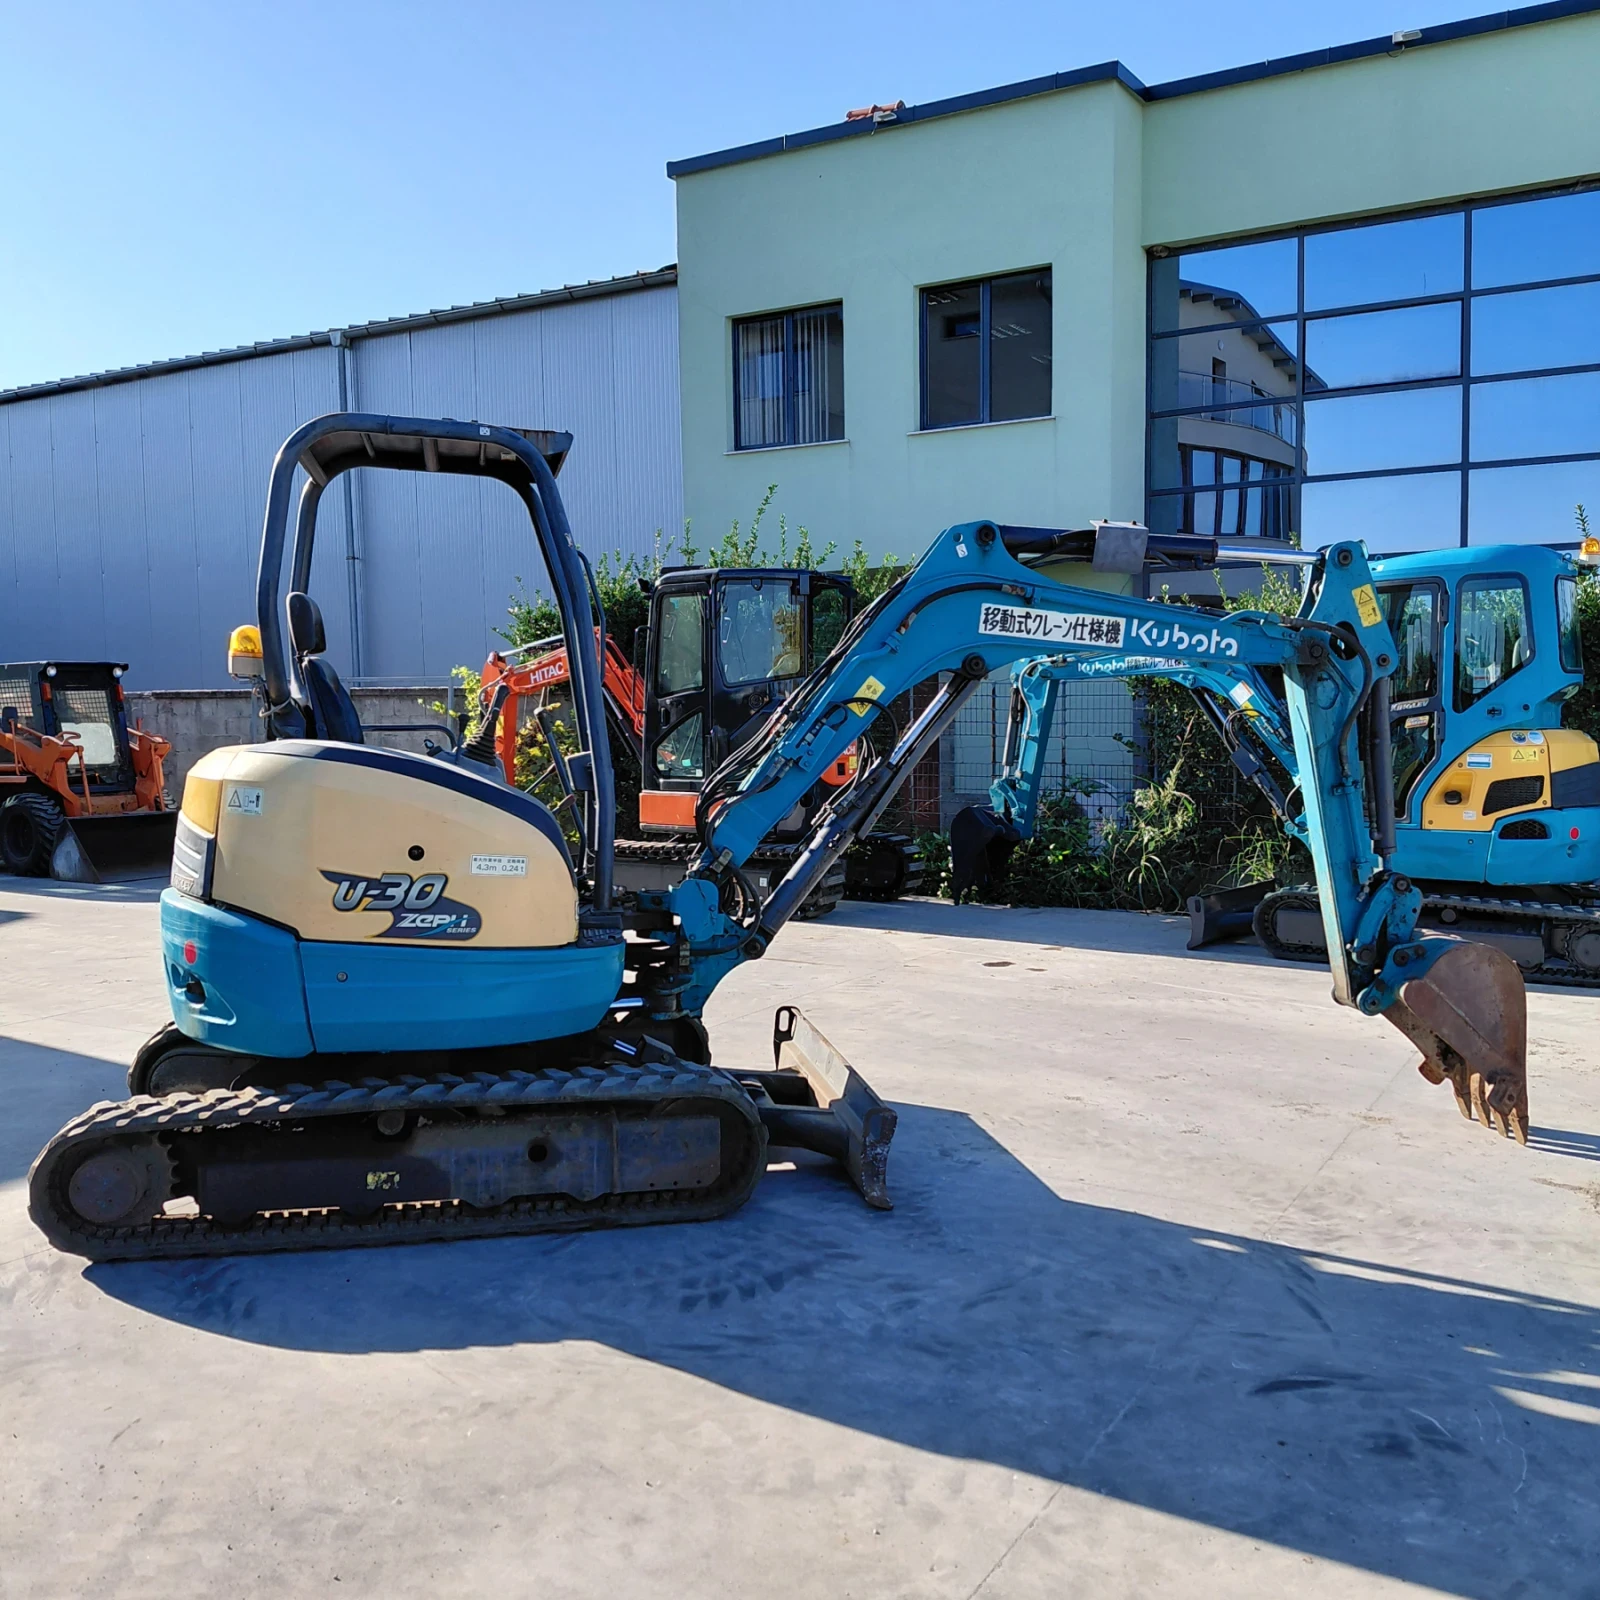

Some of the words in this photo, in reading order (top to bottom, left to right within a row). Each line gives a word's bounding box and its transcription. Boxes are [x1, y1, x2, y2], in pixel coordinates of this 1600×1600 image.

[982, 605, 1121, 645] 移動式クレーン仕様機
[1131, 618, 1239, 657] Kubota
[1078, 659, 1126, 673] Kubota
[476, 863, 497, 872] 4.3m
[501, 864, 519, 872] 0.24
[333, 873, 448, 912] U-30
